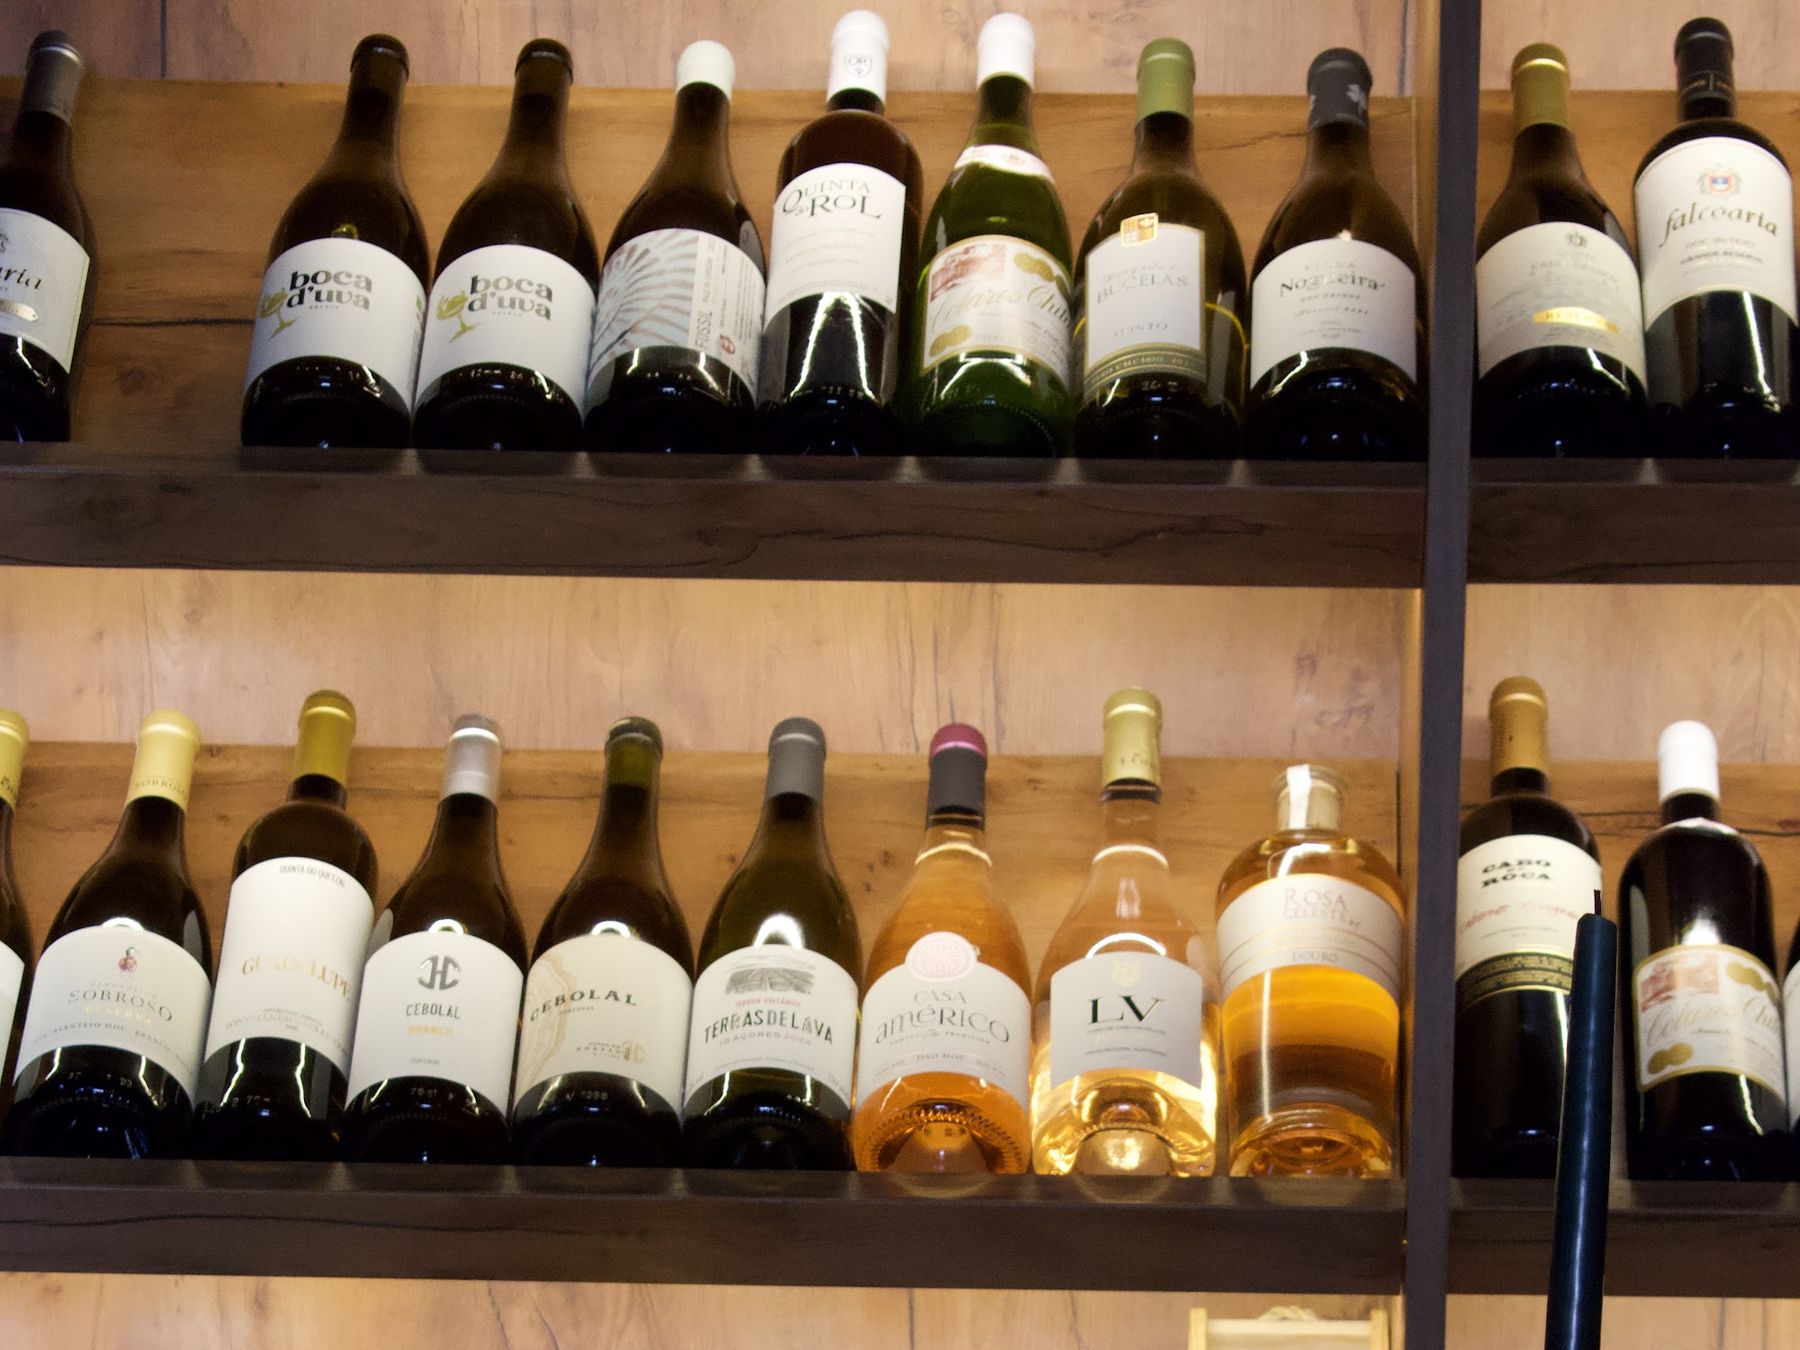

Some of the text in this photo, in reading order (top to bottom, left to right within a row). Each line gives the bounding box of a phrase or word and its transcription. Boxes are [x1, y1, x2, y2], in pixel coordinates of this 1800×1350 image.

[810, 194, 882, 219] ROL
[1658, 201, 1778, 249] falcoaria
[289, 269, 373, 293] boca
[470, 275, 553, 299] boca
[1280, 270, 1385, 298] Nogeira
[286, 285, 370, 312] d'uva
[468, 290, 552, 320] d'uva
[1482, 858, 1552, 874] CABO
[1481, 871, 1553, 888] ROCA
[1284, 886, 1349, 911] ROSA
[242, 954, 351, 999] GUDLUPE
[67, 988, 173, 1022] SOBROSO
[529, 988, 638, 1022] CEBOLAL
[913, 989, 968, 1005] CASA
[1088, 995, 1166, 1025] LV
[405, 1002, 462, 1020] CEBOLAL
